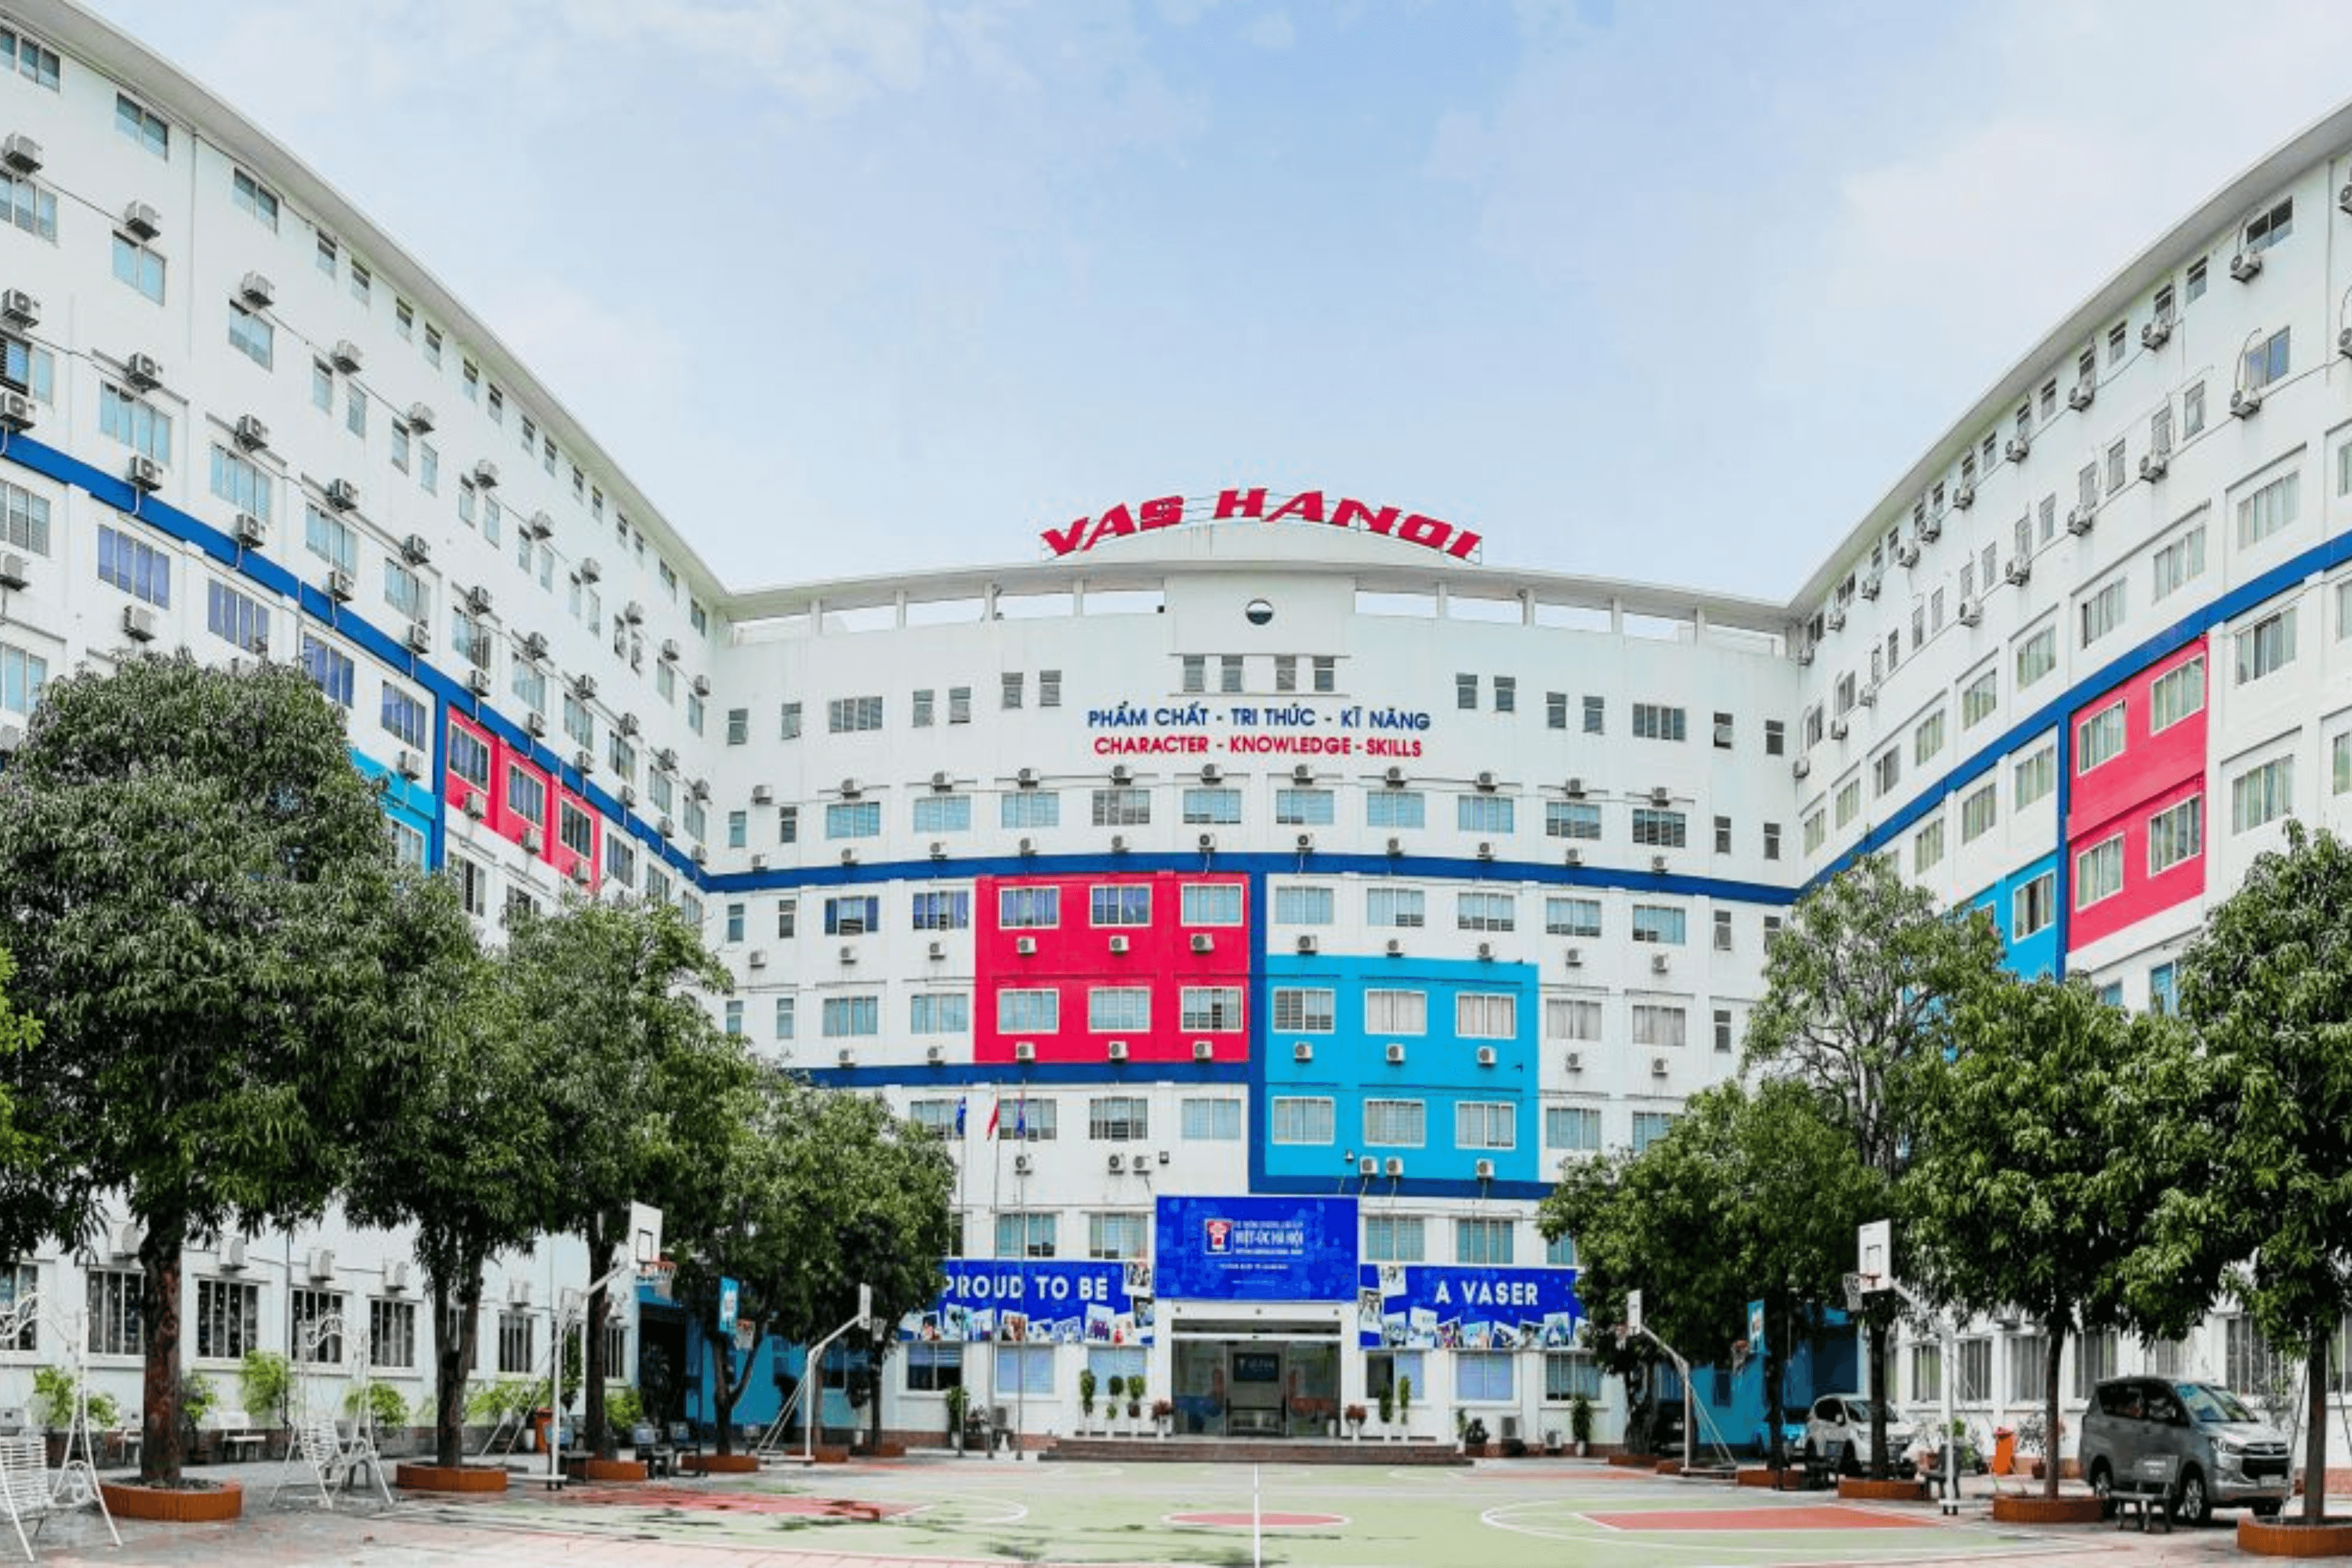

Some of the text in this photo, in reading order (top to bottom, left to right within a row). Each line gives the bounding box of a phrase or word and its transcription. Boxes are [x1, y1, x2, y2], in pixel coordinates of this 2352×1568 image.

[1040, 487, 1482, 560] VAS HANOI
[1088, 701, 1148, 728] PHẨM
[1154, 701, 1209, 726] CHẤT
[1231, 708, 1258, 726] TRI
[1264, 702, 1316, 726] THỨC
[1341, 706, 1362, 728] KĨ
[1369, 707, 1431, 730] NĂNG
[1094, 736, 1209, 755] CHARACTER
[1230, 735, 1351, 755] KNOWLEDGE
[1365, 737, 1422, 757] SKILLS
[941, 1275, 1108, 1300] PROUD TO BE
[1435, 1280, 1539, 1305] A VASER
